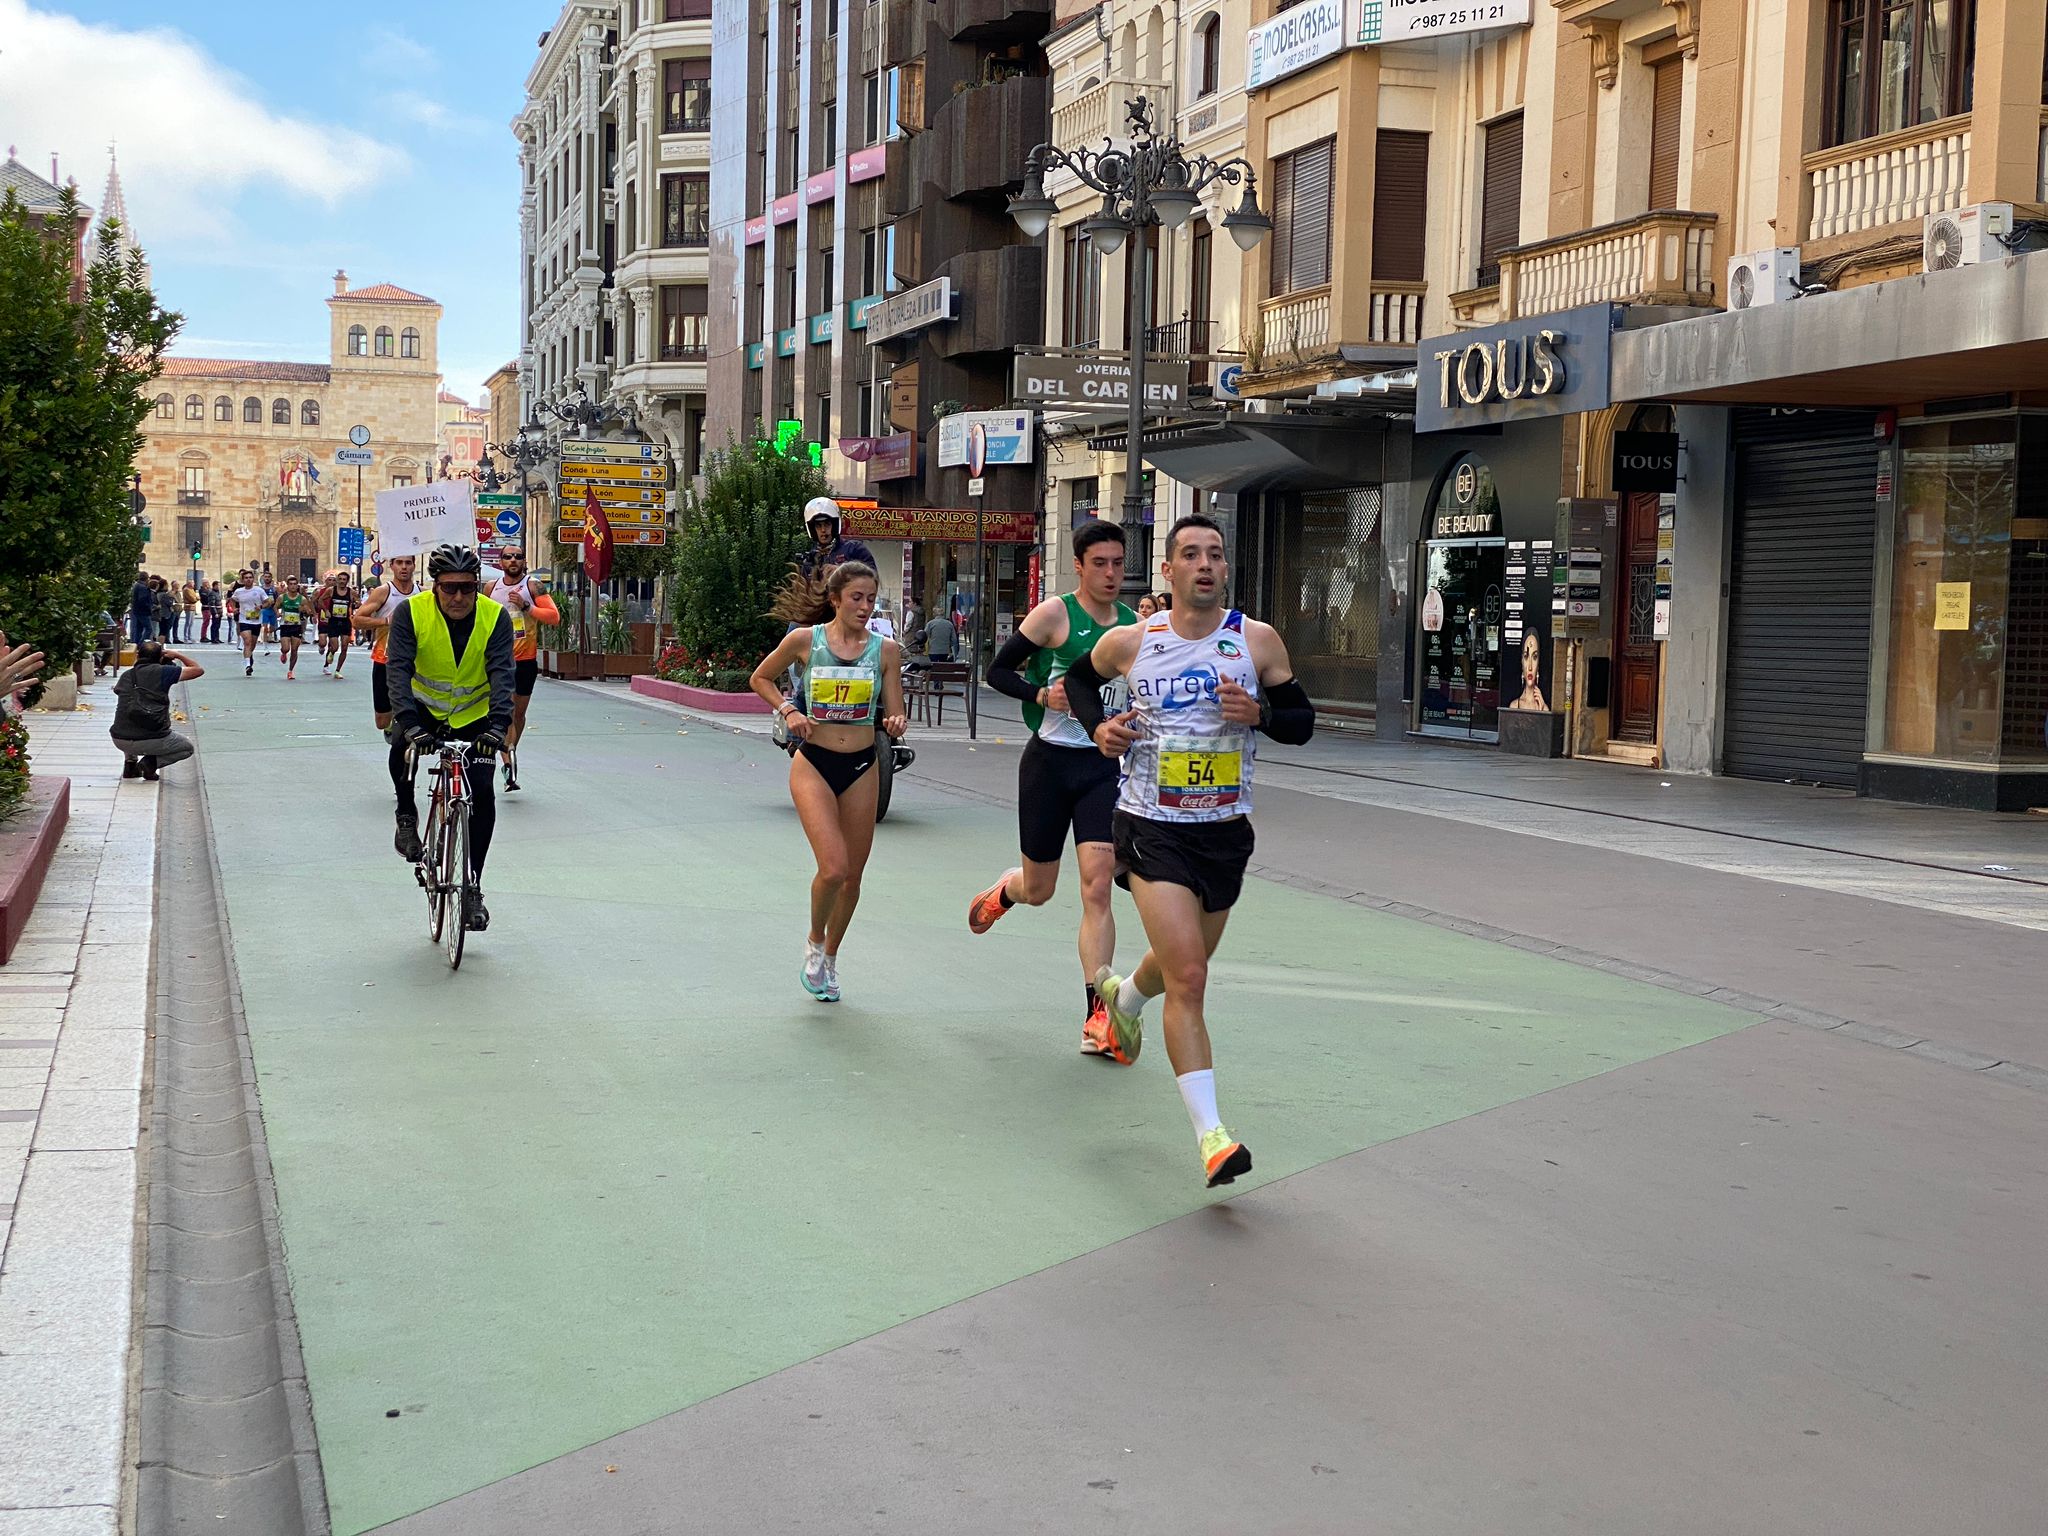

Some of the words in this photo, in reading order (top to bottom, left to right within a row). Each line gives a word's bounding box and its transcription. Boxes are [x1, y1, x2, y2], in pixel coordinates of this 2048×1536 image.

[1422, 13, 1445, 28] 987
[1449, 11, 1466, 25] 25
[1471, 8, 1485, 21] 11
[1489, 5, 1504, 19] 21
[1286, 56, 1297, 67] 987
[1297, 53, 1305, 65] 25
[1305, 50, 1311, 61] 11
[1311, 44, 1319, 57] 21
[1076, 364, 1131, 376] JOYERIA
[1434, 329, 1561, 408] TOUS
[1027, 378, 1070, 396] DEL
[1082, 380, 1178, 400] CAREN
[1620, 454, 1673, 470] TOUS
[1458, 476, 1470, 492] BE
[404, 496, 445, 508] PRIMERA
[1073, 499, 1098, 510] ESTRELLA
[404, 506, 446, 521] MUJER
[842, 510, 904, 521] ROYAL
[911, 511, 1012, 524] TANDOORI
[1439, 516, 1452, 534] BE
[1452, 514, 1494, 533] BEAUTY
[946, 530, 976, 538] Cuisin
[1486, 595, 1499, 612] BE
[834, 684, 850, 703] 17
[1188, 760, 1214, 786] 54
